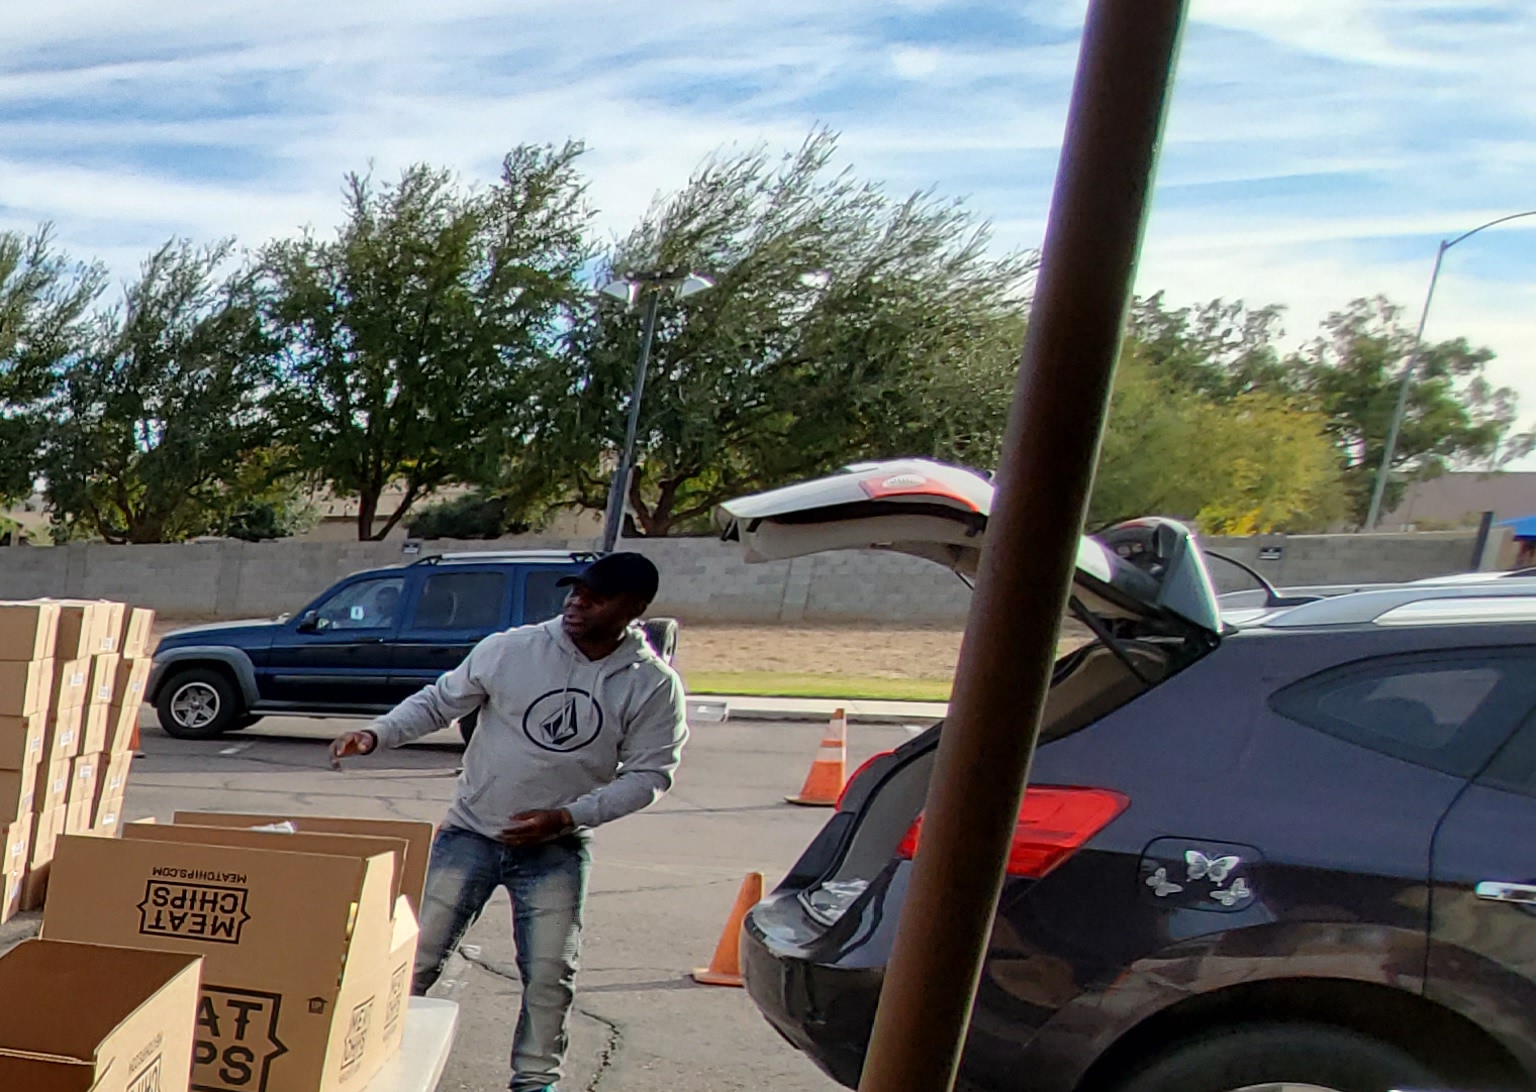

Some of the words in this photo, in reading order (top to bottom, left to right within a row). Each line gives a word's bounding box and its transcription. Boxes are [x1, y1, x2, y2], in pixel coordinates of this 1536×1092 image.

[152, 866, 247, 884] MEATCHIPS.COM
[152, 887, 239, 914] CHIPS
[148, 910, 235, 937] MEAT
